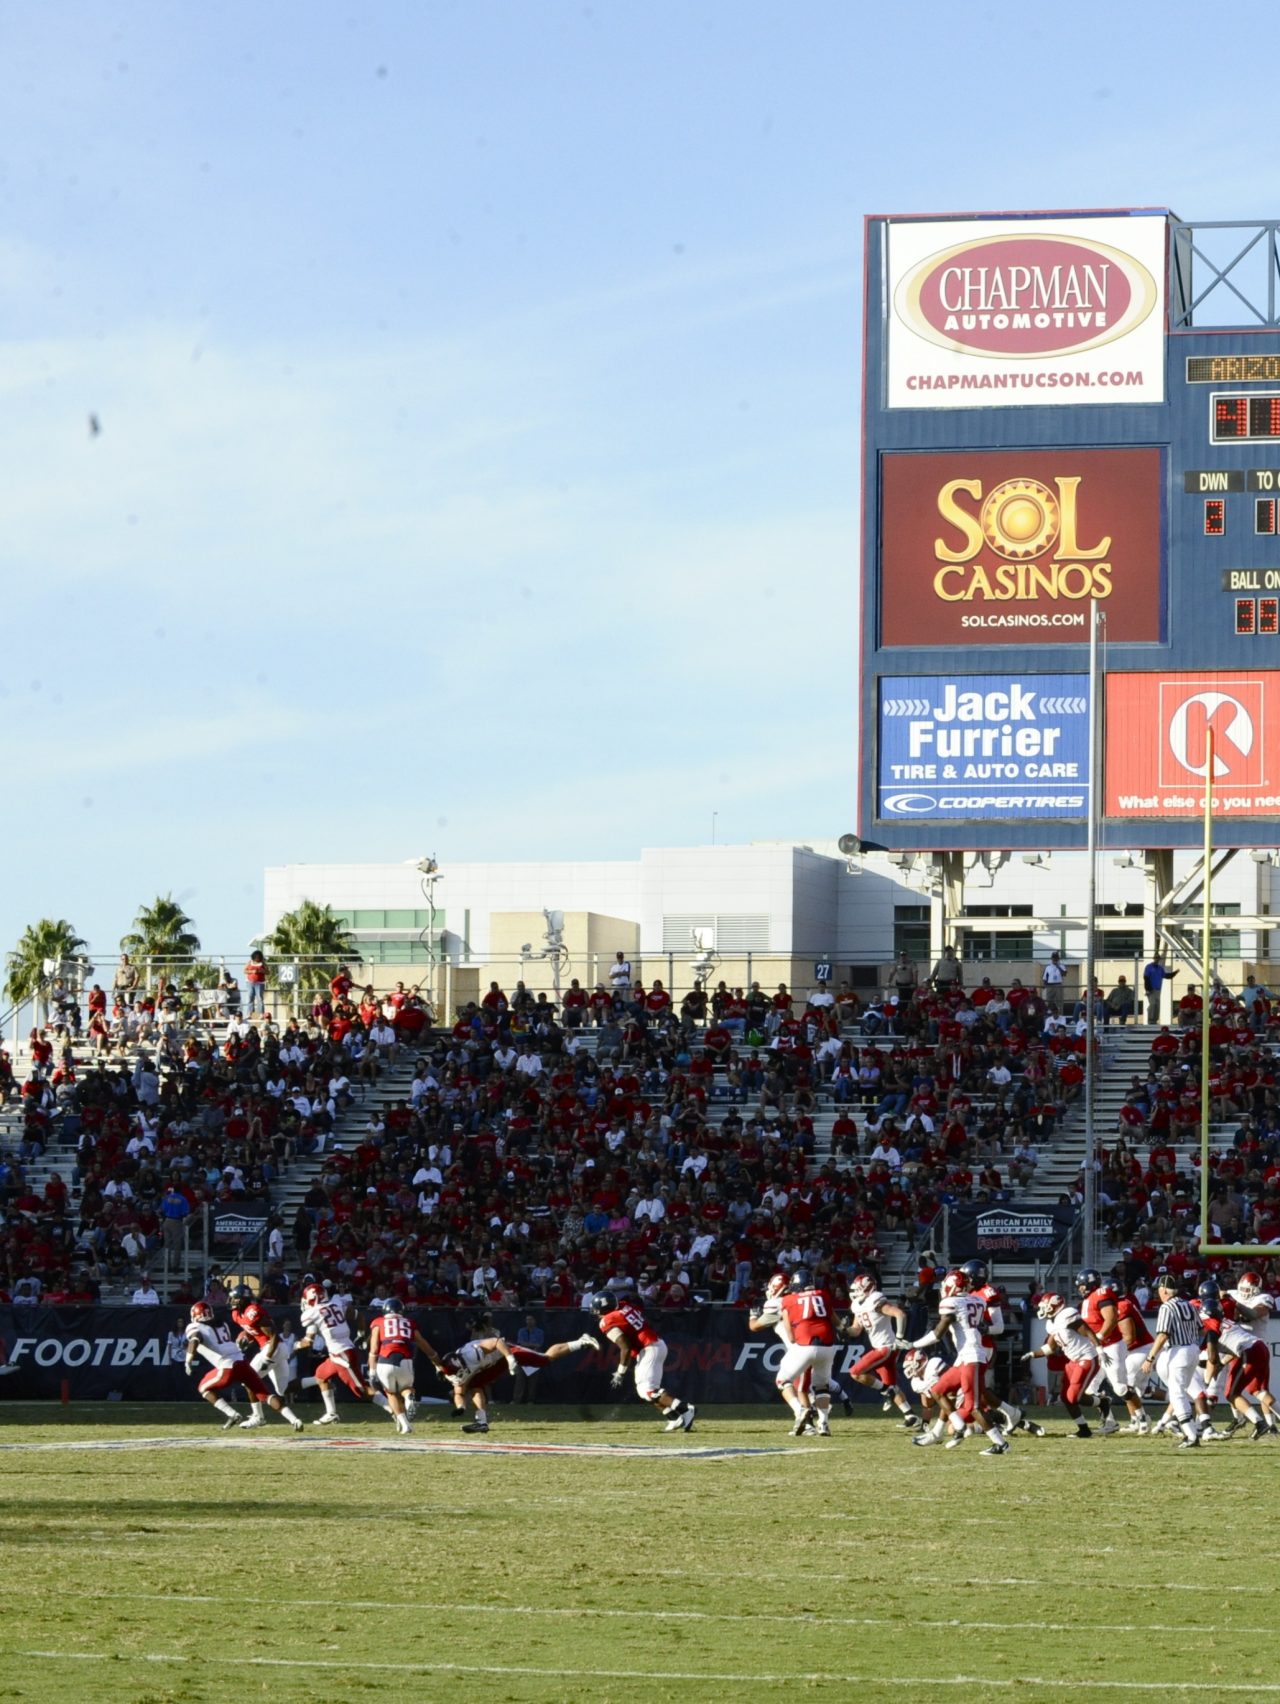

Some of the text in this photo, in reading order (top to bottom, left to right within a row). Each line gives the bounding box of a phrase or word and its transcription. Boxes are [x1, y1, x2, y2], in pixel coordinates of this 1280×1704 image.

[939, 264, 1110, 312] CHAPMAN
[944, 312, 1107, 330] AUTOMOTIVE
[906, 371, 1144, 391] CHAPMANTUCSON.COM
[1216, 398, 1280, 436] 41
[1200, 473, 1228, 491] DWN
[1257, 471, 1274, 490] TO
[934, 477, 1111, 562] SOL
[1205, 501, 1223, 533] 2
[933, 563, 1112, 602] CASINOS
[1230, 571, 1260, 589] BALL
[961, 613, 1085, 628] SOLCASINOS.COM
[1237, 600, 1278, 632] 35
[933, 684, 1037, 723] Jack
[909, 721, 1061, 758] Furrier
[891, 762, 1079, 779] TIRE & AUTO CARE
[1118, 794, 1160, 808] What
[1163, 793, 1195, 808] else
[1223, 797, 1251, 810] you
[280, 966, 294, 982] 26
[817, 964, 830, 980] 27
[978, 1218, 1053, 1226] AMERICAN FAMILY
[320, 1304, 346, 1328] 26
[797, 1295, 828, 1319] 78
[384, 1318, 412, 1339] 85
